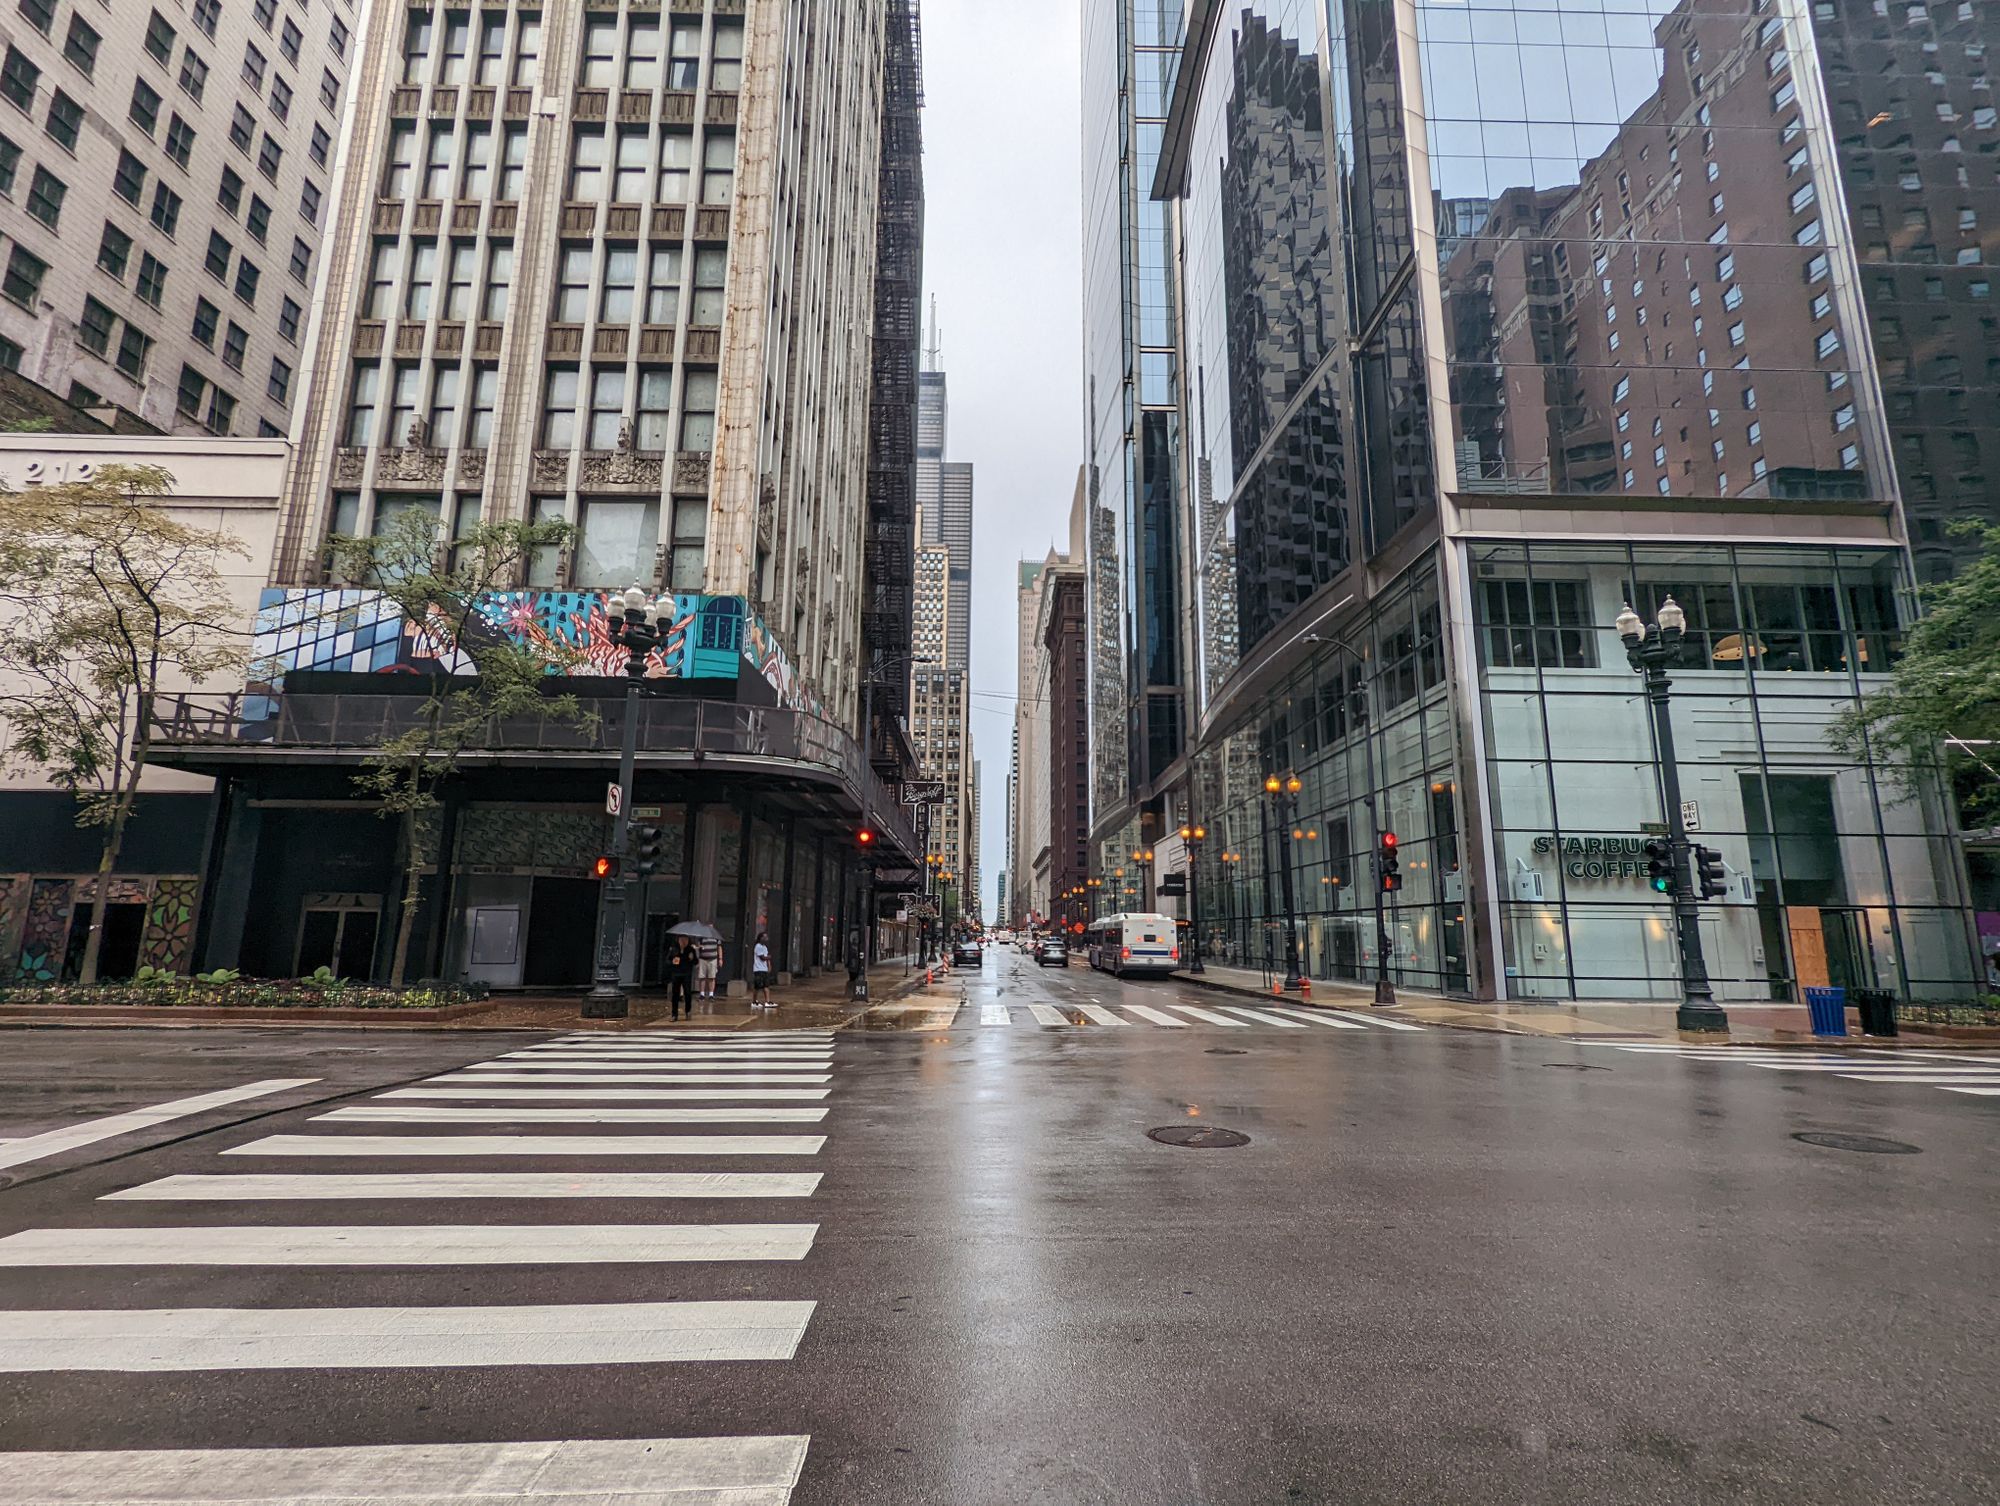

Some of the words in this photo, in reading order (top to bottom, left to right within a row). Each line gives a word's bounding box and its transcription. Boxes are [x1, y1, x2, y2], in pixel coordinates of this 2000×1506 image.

[25, 458, 98, 484] 212
[1682, 803, 1696, 812] ONE
[1683, 811, 1696, 820] WAY
[1567, 861, 1652, 879] COFFE
